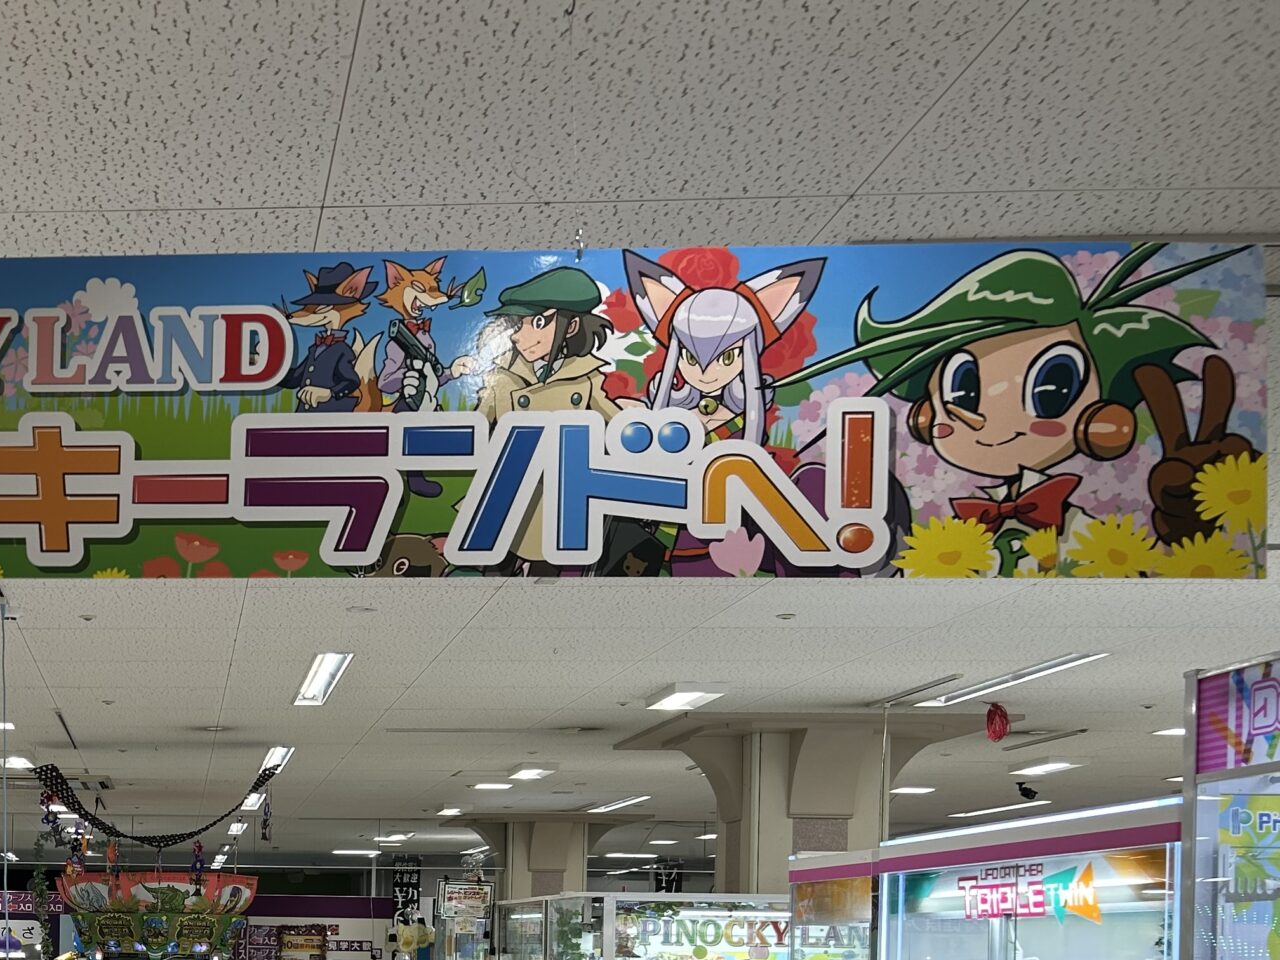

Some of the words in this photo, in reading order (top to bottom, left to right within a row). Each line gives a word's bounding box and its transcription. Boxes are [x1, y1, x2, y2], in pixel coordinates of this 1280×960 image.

[29, 308, 287, 386] LAND
[980, 867, 998, 880] UFO
[1000, 863, 1043, 879] CATCHER
[958, 876, 1046, 920] TRIPLE
[19, 903, 33, 911] 入口
[49, 904, 63, 912] 入口
[262, 937, 277, 945] 入口
[638, 918, 789, 948] PINOCKY
[800, 925, 871, 949] LAN
